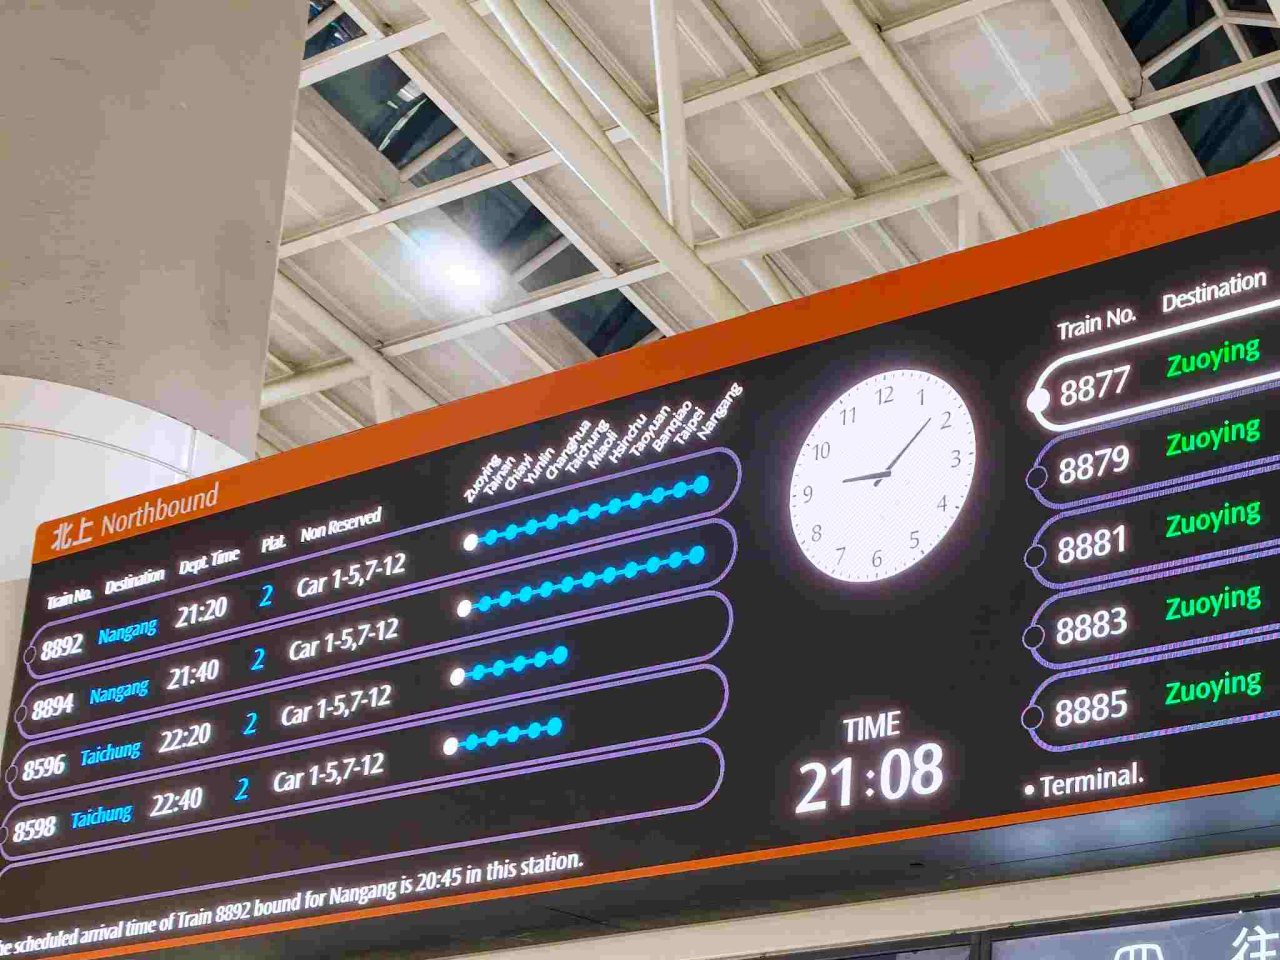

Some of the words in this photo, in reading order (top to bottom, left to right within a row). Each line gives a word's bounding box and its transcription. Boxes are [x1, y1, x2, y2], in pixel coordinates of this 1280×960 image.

[1162, 271, 1267, 312] Destination
[1056, 314, 1102, 341] Train
[1106, 307, 1137, 328] No.
[1060, 364, 1131, 407] 8877
[1166, 338, 1261, 379] Zuoying
[697, 382, 744, 441] Nangang
[878, 385, 895, 406] 12
[920, 388, 924, 406] 1
[629, 404, 672, 457] Taoyuan
[652, 400, 693, 452] Banqiao
[672, 406, 706, 446] Taipei
[839, 406, 856, 426] 11
[940, 410, 952, 430] 2
[545, 419, 592, 480] Changhua
[565, 418, 611, 474] Taichung
[586, 428, 619, 470] Miaoli
[608, 412, 648, 464] Hsinchu
[812, 441, 831, 461] 10
[1058, 444, 1130, 485] 8879
[1166, 418, 1262, 458] Zuoying
[463, 453, 502, 504] Zuoying
[482, 456, 517, 496] Tainan
[504, 453, 534, 491] Chiayi
[523, 446, 556, 485] Yunlin
[950, 449, 962, 469] 3
[101, 482, 219, 537] Northbound
[803, 484, 813, 504] 9
[936, 494, 948, 513] 4
[51, 517, 94, 550] 北上
[261, 534, 287, 553] Plat.
[300, 525, 327, 543] Non
[327, 505, 383, 535] Reserved
[811, 524, 822, 543] 8
[909, 530, 920, 550] 5
[1057, 524, 1125, 564] 8881
[1165, 500, 1262, 539] Zuoying
[210, 548, 241, 567] Time
[835, 546, 847, 566] 7
[871, 549, 883, 568] 6
[46, 591, 74, 610] Train
[104, 568, 166, 595] Destination
[40, 633, 84, 661] 8892
[96, 618, 159, 645] Nangang
[174, 596, 228, 629] 21:20
[259, 583, 275, 608] 2
[296, 576, 329, 598] Car
[332, 552, 406, 589] 1-5,7-12
[1056, 606, 1128, 645] 8883
[1165, 585, 1262, 621] Zuoying
[31, 692, 75, 721] 8894
[89, 679, 150, 705] Nangang
[166, 658, 220, 690] 21:40
[250, 646, 266, 671] 2
[288, 640, 321, 661] Car
[324, 617, 399, 653] 1-5,7-12
[1055, 688, 1128, 728] 8885
[1164, 672, 1263, 706] Zuoying
[21, 753, 67, 782] 8596
[81, 742, 142, 766] Taichung
[158, 722, 212, 754] 22:20
[242, 711, 259, 737] 2
[280, 705, 313, 727] Car
[316, 684, 392, 719] 1-5,7-12
[842, 710, 901, 743] TIME
[12, 815, 57, 843] 8598
[71, 804, 134, 829] Taichung
[149, 786, 203, 818] 22:40
[234, 776, 250, 802] 2
[273, 771, 306, 793] Car
[308, 752, 385, 786] 1-5,7-12
[795, 742, 944, 814] 21:08
[1039, 761, 1144, 798] Terminal.
[0, 942, 14, 957] he
[14, 927, 79, 953] scheduled
[81, 920, 124, 944] arrival
[126, 918, 157, 937] time
[159, 913, 176, 932] of
[176, 909, 213, 928] Train
[215, 902, 251, 923] 8892
[252, 891, 303, 918] bound
[304, 890, 328, 909] for
[328, 881, 399, 906] Nangang
[399, 875, 414, 895] is
[414, 867, 463, 892] 20:45
[465, 864, 482, 885] in
[486, 859, 518, 881] this
[519, 851, 584, 876] station.
